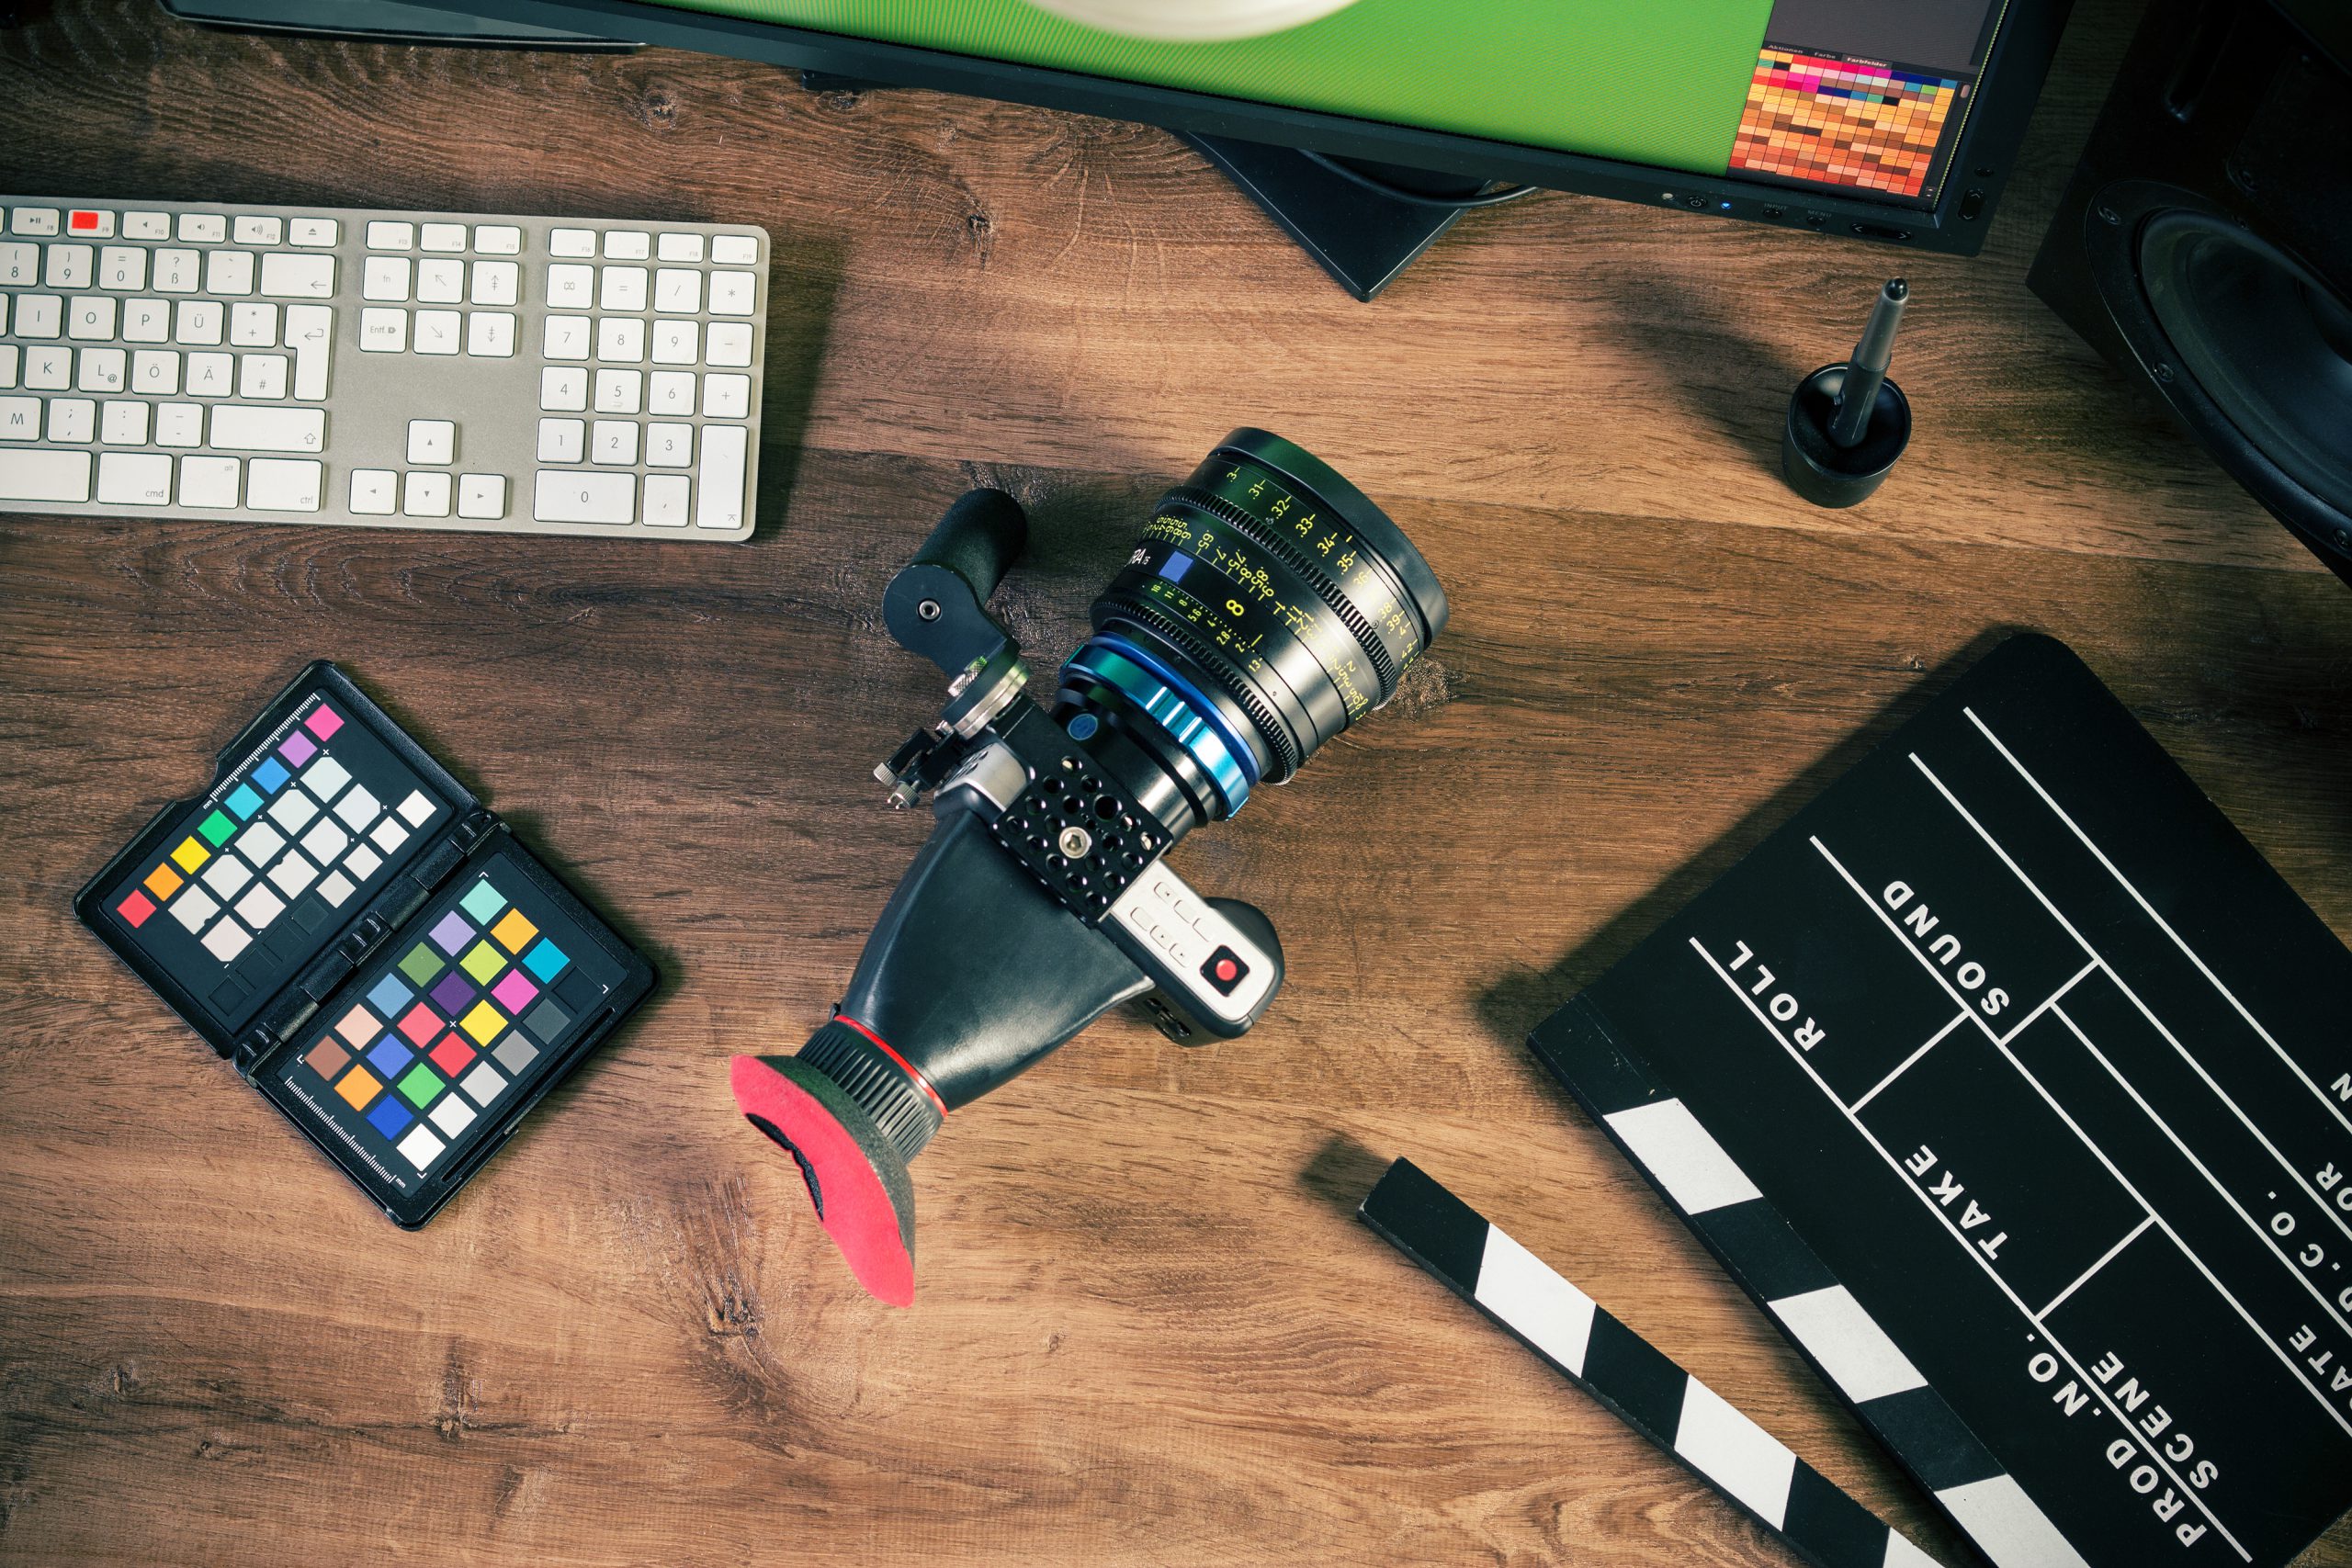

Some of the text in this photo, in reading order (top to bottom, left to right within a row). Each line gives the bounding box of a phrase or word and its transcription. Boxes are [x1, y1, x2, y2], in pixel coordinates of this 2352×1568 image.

[1847, 57, 1888, 67] Farbfelder
[1764, 202, 1788, 210] INPUT
[1807, 209, 1833, 218] MENU
[11, 265, 18, 277] 8
[63, 268, 72, 279] 9
[141, 313, 150, 326] P
[194, 312, 204, 328] Ü
[563, 331, 571, 344] 7
[616, 333, 625, 345] 8
[671, 335, 679, 348] 9
[43, 362, 52, 374] K
[97, 364, 104, 376] L
[149, 363, 160, 378] Ö
[203, 365, 213, 380] Ä
[560, 383, 568, 395] 4
[614, 385, 622, 397] 5
[668, 388, 675, 399] 6
[10, 412, 24, 425] M
[559, 434, 563, 446] 1
[611, 436, 618, 449] 2
[665, 439, 673, 451] 3
[145, 489, 164, 498] cmd
[581, 491, 589, 503] 0
[300, 496, 313, 504] ctrl
[1249, 483, 1263, 500] .31
[1271, 500, 1290, 520] .32
[1295, 517, 1313, 538] .33
[1317, 536, 1336, 558] .34
[1337, 553, 1354, 575] .35
[1197, 529, 1215, 549] .65
[1227, 548, 1246, 570] .75
[1250, 566, 1269, 588] .85
[1150, 584, 1161, 592] 16
[1164, 591, 1174, 599] 11
[1187, 608, 1203, 622] 5.6
[1216, 630, 1231, 646] 2.8
[1235, 643, 1245, 653] 2
[1883, 880, 2009, 1016] SOUND
[1729, 940, 1826, 1052] ROLL
[1904, 1145, 2008, 1260] TAKE
[2289, 1324, 2352, 1410] ATE
[2090, 1350, 2219, 1489] SCENE
